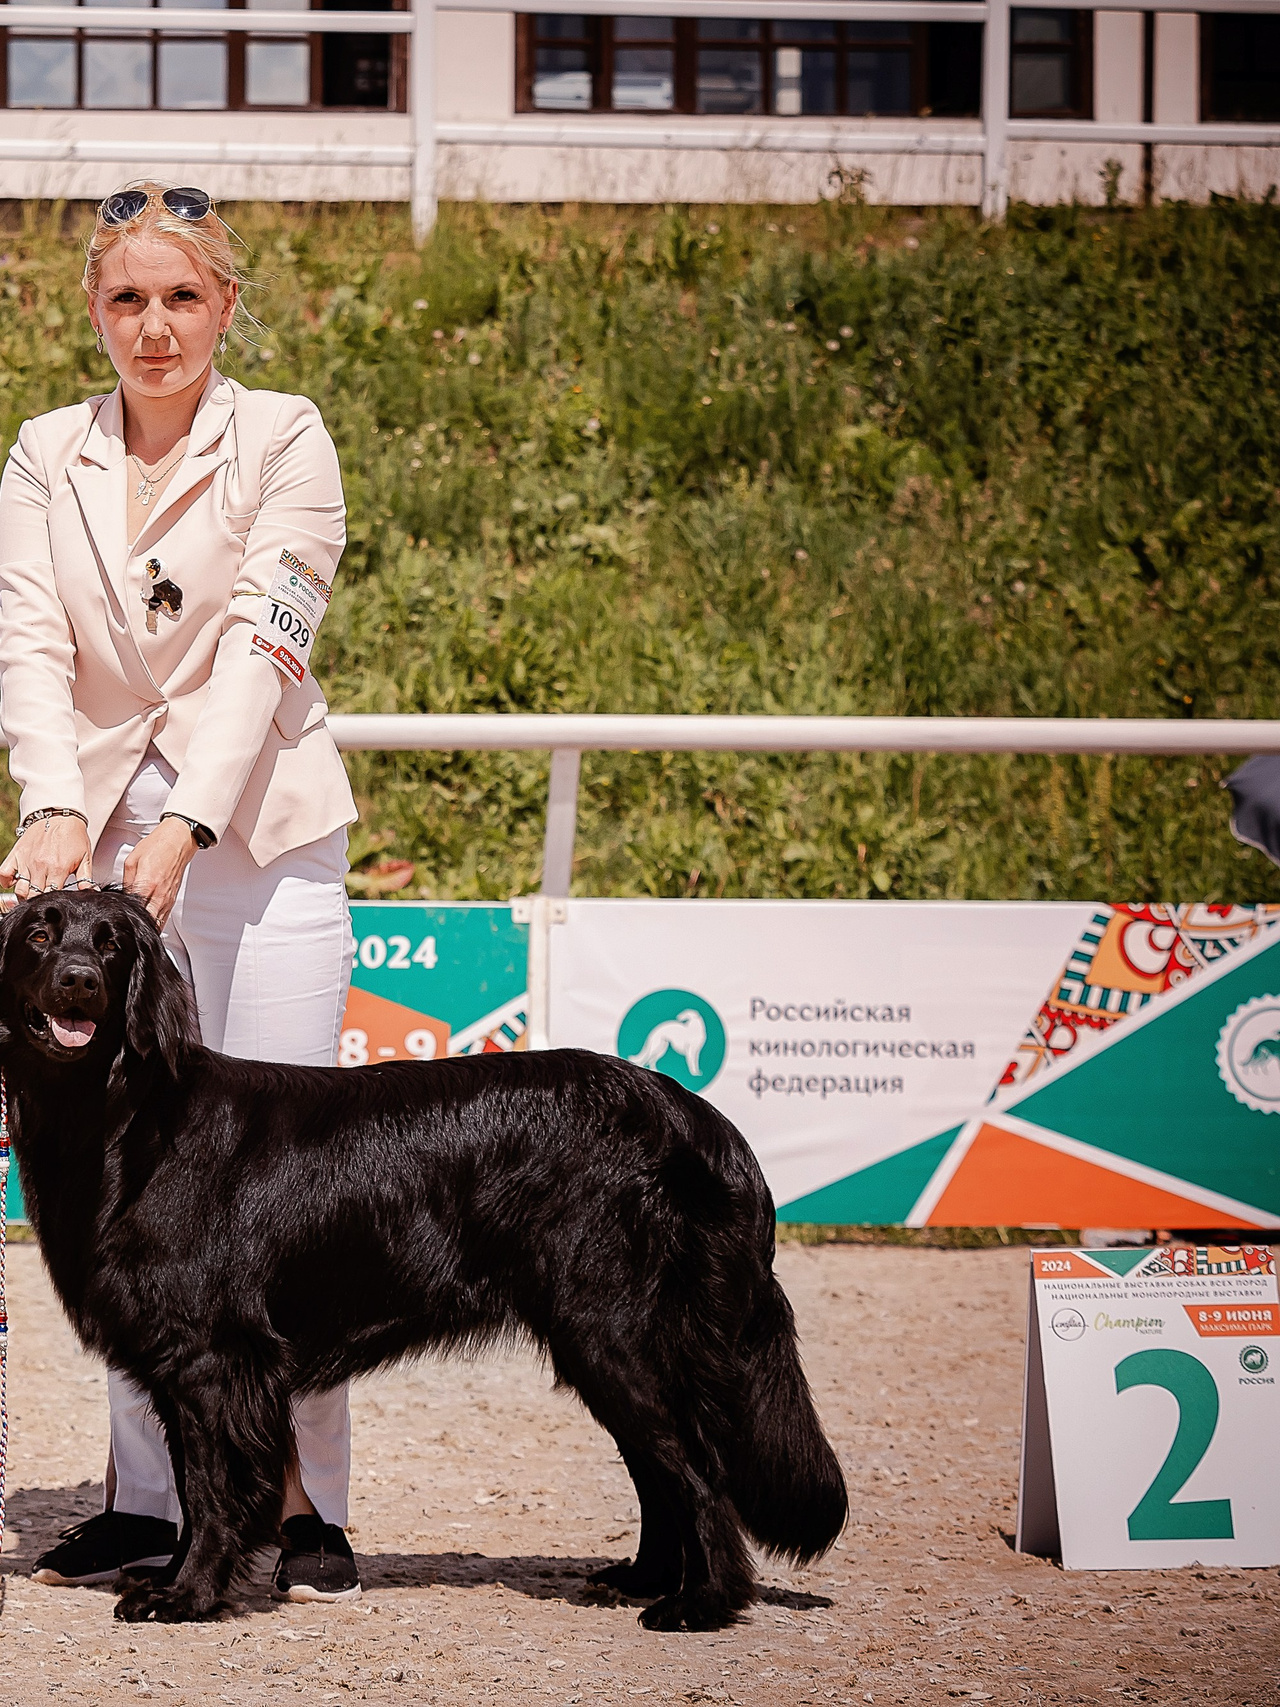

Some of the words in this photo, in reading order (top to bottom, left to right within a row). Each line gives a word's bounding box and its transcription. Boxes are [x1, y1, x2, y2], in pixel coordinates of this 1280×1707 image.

[269, 603, 310, 648] 1029
[749, 997, 912, 1023] Российская
[748, 1039, 976, 1059] кинологическая
[748, 1067, 905, 1100] федерация
[1041, 1260, 1072, 1272] 2024
[1043, 1282, 1121, 1290] НАЦИОНАЛЬНЫЕ
[1124, 1281, 1174, 1289] ВЫСТАВКИ
[1176, 1280, 1207, 1288] СОБАК
[1235, 1279, 1268, 1287] ПОРОД
[1051, 1292, 1129, 1301] НАЦИОНАЛЬНЫЕ
[1132, 1290, 1210, 1299] МОНОПОРОДНЫЕ
[1213, 1290, 1263, 1298] ВЫСТАВКИ
[1094, 1312, 1165, 1332] Champion
[1198, 1311, 1222, 1322] 8-9
[1226, 1310, 1273, 1321] ИЮНЯ
[1200, 1323, 1247, 1332] МАКСИМА
[1249, 1323, 1273, 1331] ПАРК
[1238, 1377, 1275, 1386] РОССИЯ
[1114, 1348, 1235, 1541] 2
